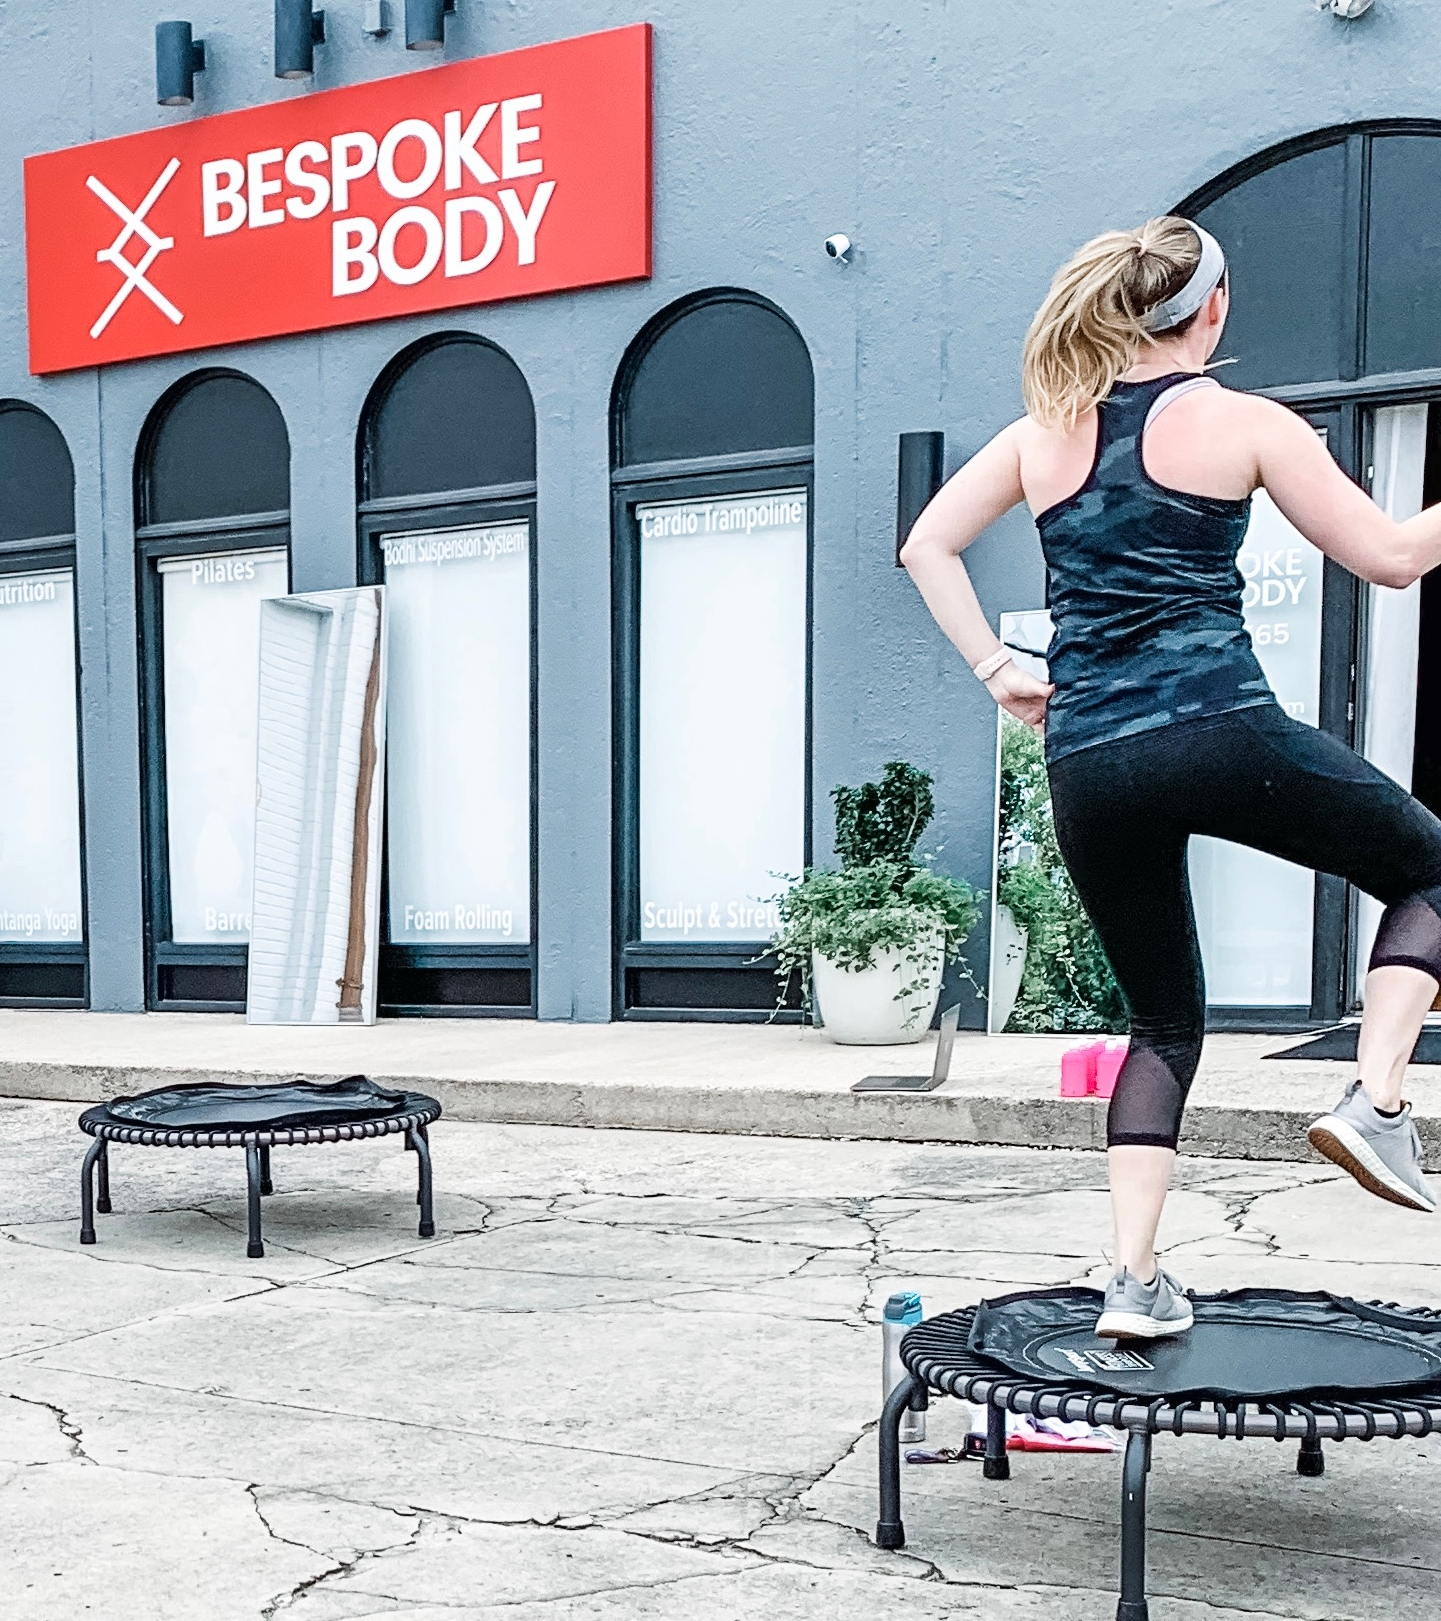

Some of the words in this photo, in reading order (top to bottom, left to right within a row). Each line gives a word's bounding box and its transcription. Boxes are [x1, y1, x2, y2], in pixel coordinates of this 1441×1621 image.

[201, 93, 543, 238] BESPOKE
[331, 180, 557, 298] BODY
[641, 507, 698, 538] Cardio
[704, 498, 803, 535] Trampoline
[384, 538, 416, 566] Bodhi
[417, 534, 481, 566] Suspension
[482, 529, 525, 562] System
[191, 558, 255, 585] Pilates
[1241, 577, 1307, 608] ODY
[44, 907, 78, 936] Yoga
[404, 904, 450, 931] Foam
[454, 904, 512, 936] Rolling
[643, 901, 703, 935] Sculpt
[708, 901, 722, 928] &
